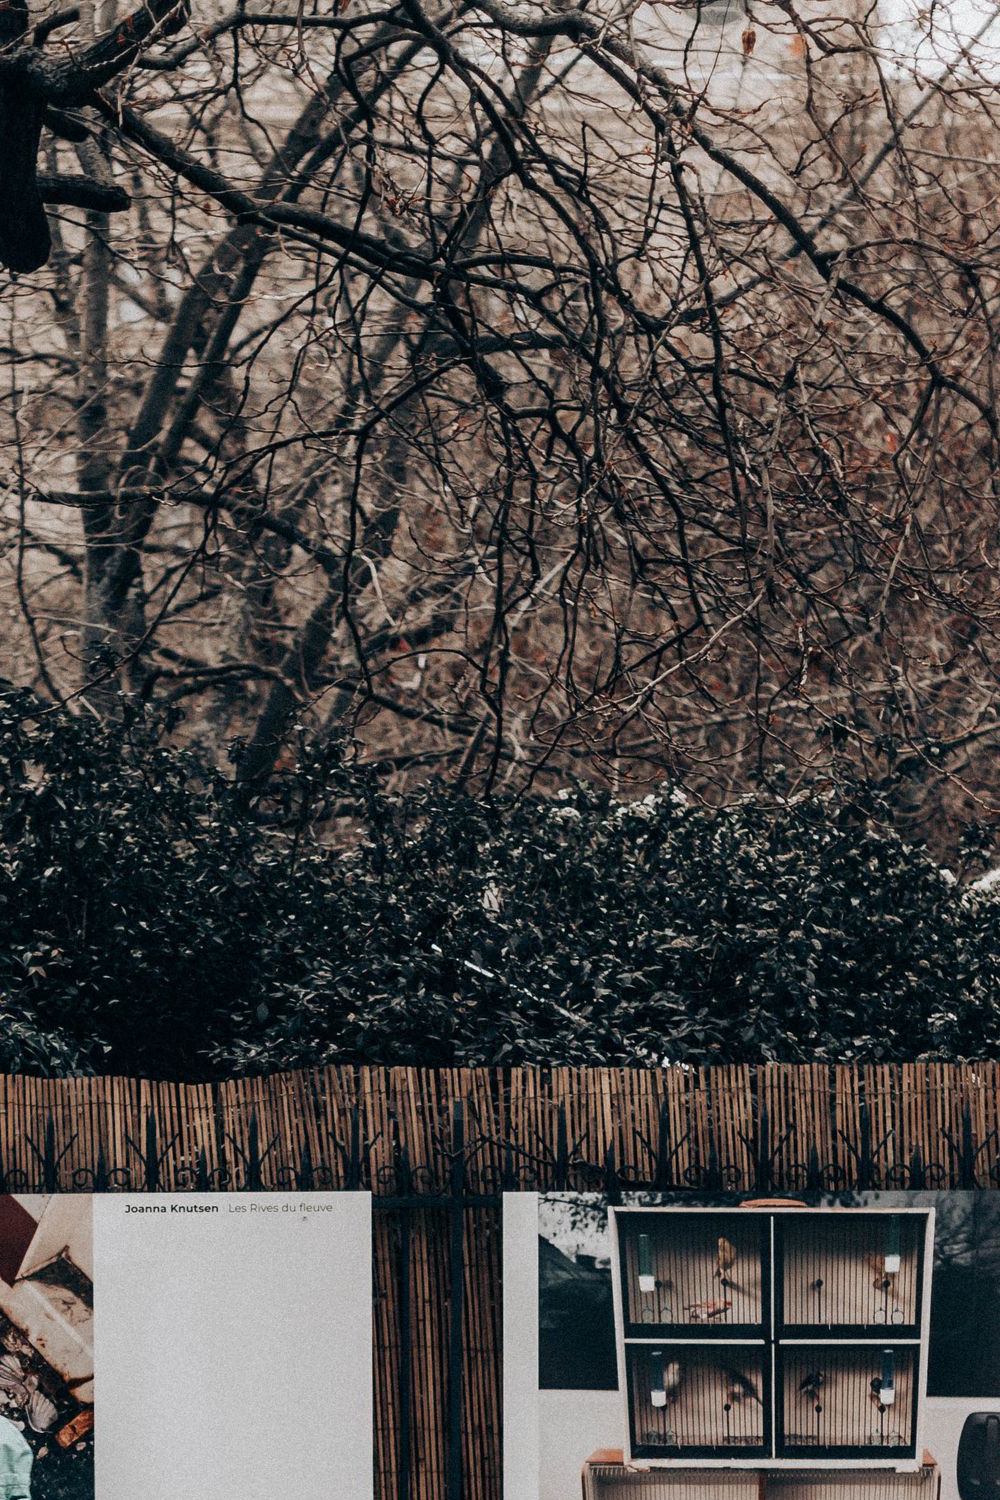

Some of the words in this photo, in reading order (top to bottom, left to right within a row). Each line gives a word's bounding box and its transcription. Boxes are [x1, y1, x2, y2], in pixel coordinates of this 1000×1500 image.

[125, 1204, 167, 1213] Joanna
[170, 1204, 219, 1213] Knutsen
[228, 1203, 247, 1213] Les
[250, 1203, 279, 1213] Rives
[281, 1203, 297, 1213] du
[299, 1203, 333, 1213] fleuve
